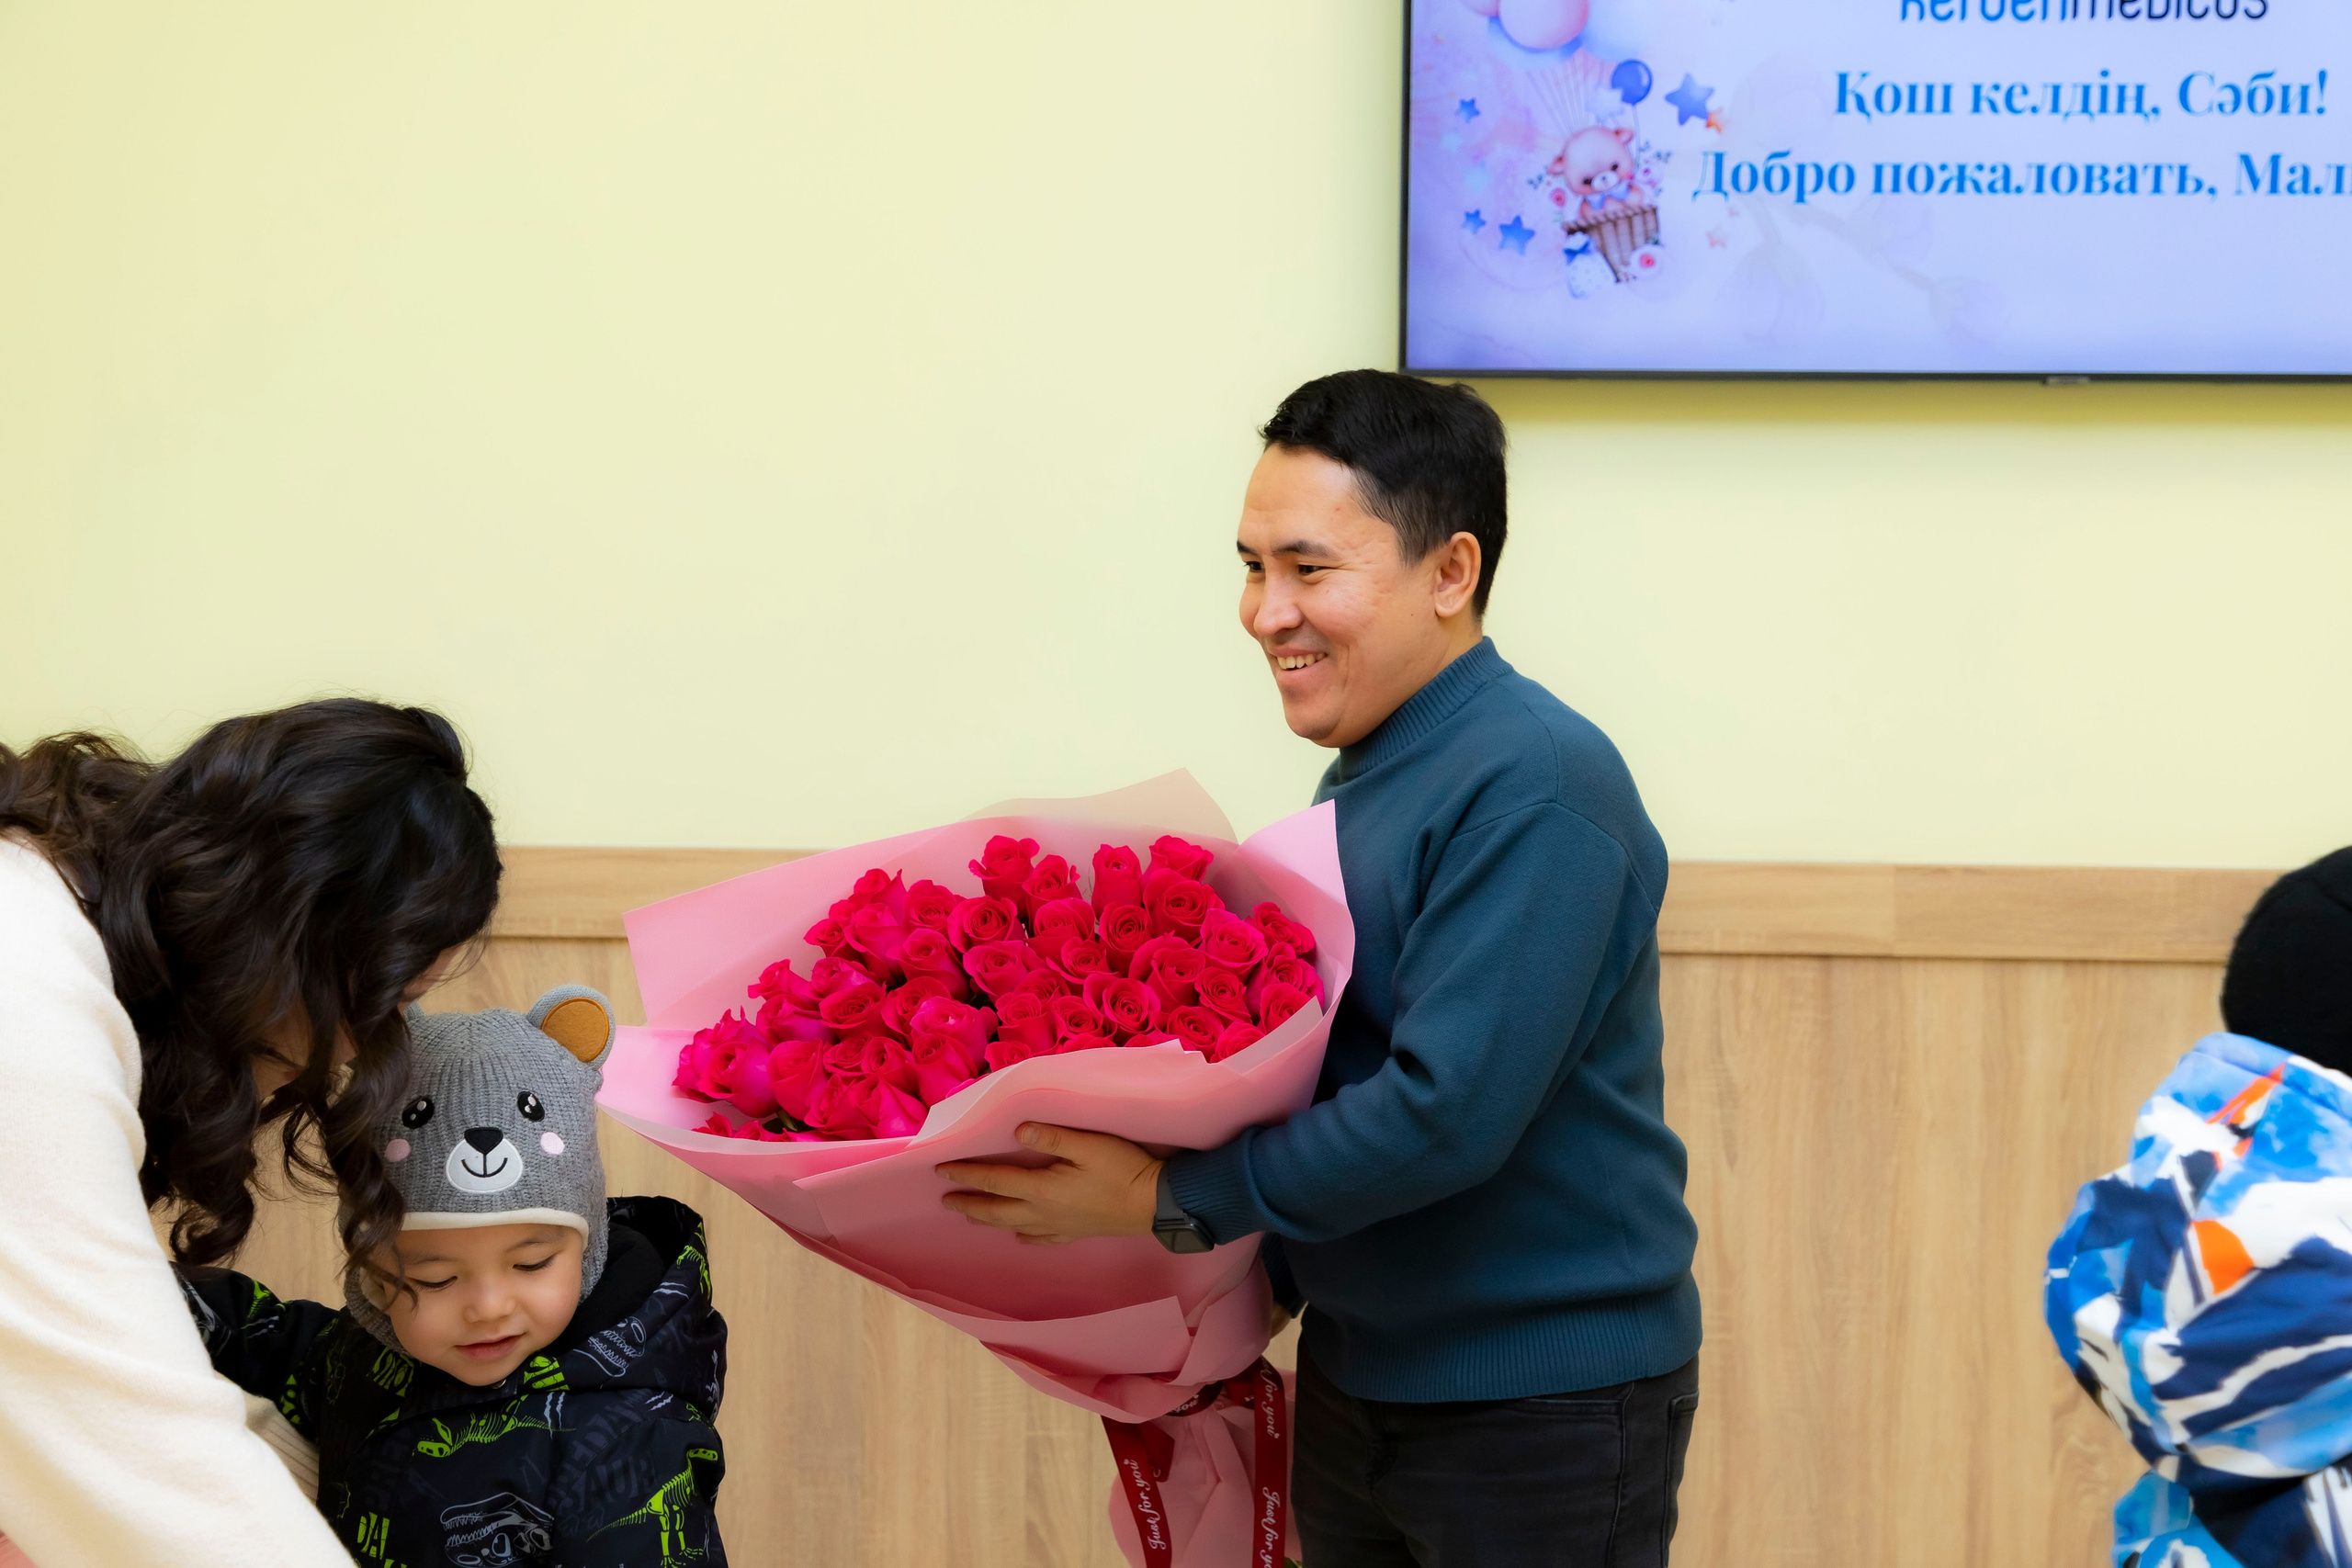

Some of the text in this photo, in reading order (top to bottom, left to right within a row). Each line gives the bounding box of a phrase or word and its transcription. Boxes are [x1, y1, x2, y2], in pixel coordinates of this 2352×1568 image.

[1835, 68, 2328, 123] Қош келдің, Сәби!
[1690, 149, 2352, 205] Добро пожаловать, Мал
[1129, 1459, 1150, 1491] you
[1138, 1491, 1160, 1521] for
[1261, 1517, 1279, 1551] for
